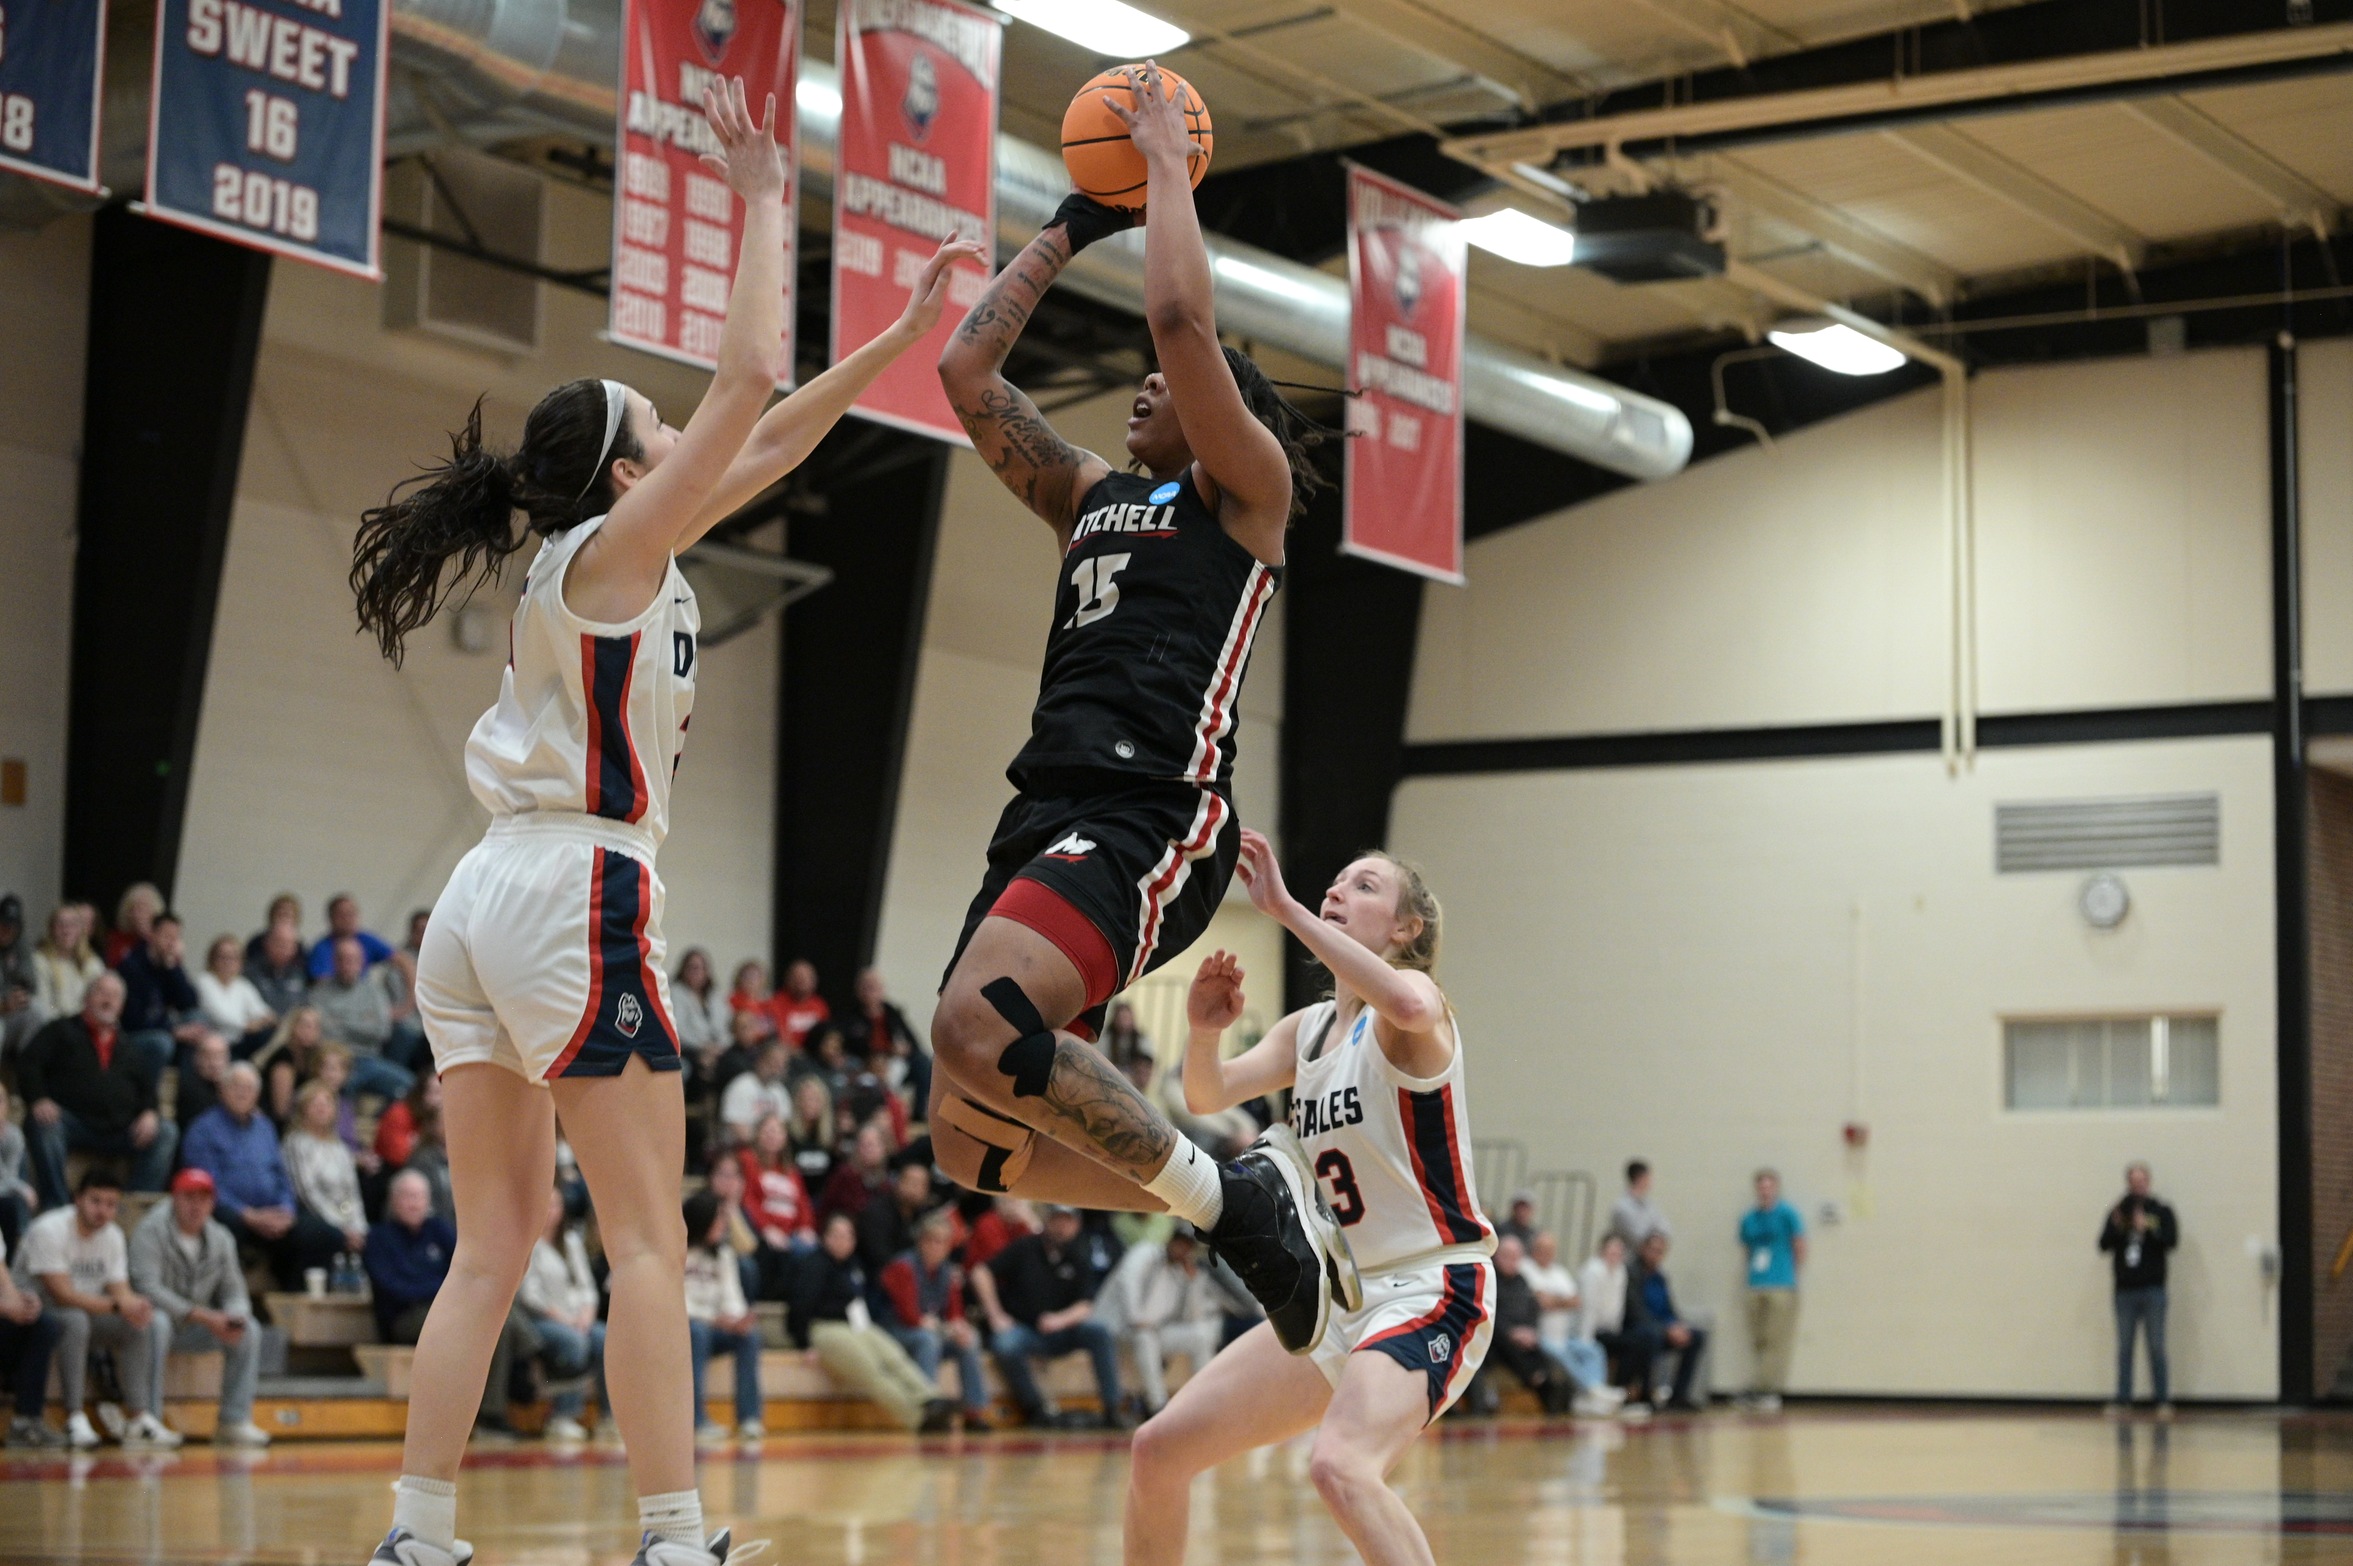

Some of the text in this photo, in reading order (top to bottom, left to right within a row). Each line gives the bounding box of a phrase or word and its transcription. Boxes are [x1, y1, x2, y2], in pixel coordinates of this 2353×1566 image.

[187, 0, 358, 98] SWEET
[245, 88, 298, 160] 16
[212, 162, 319, 241] 2019
[889, 142, 946, 196] NCAA
[1063, 552, 1132, 630] 15
[1315, 1147, 1366, 1227] 3
